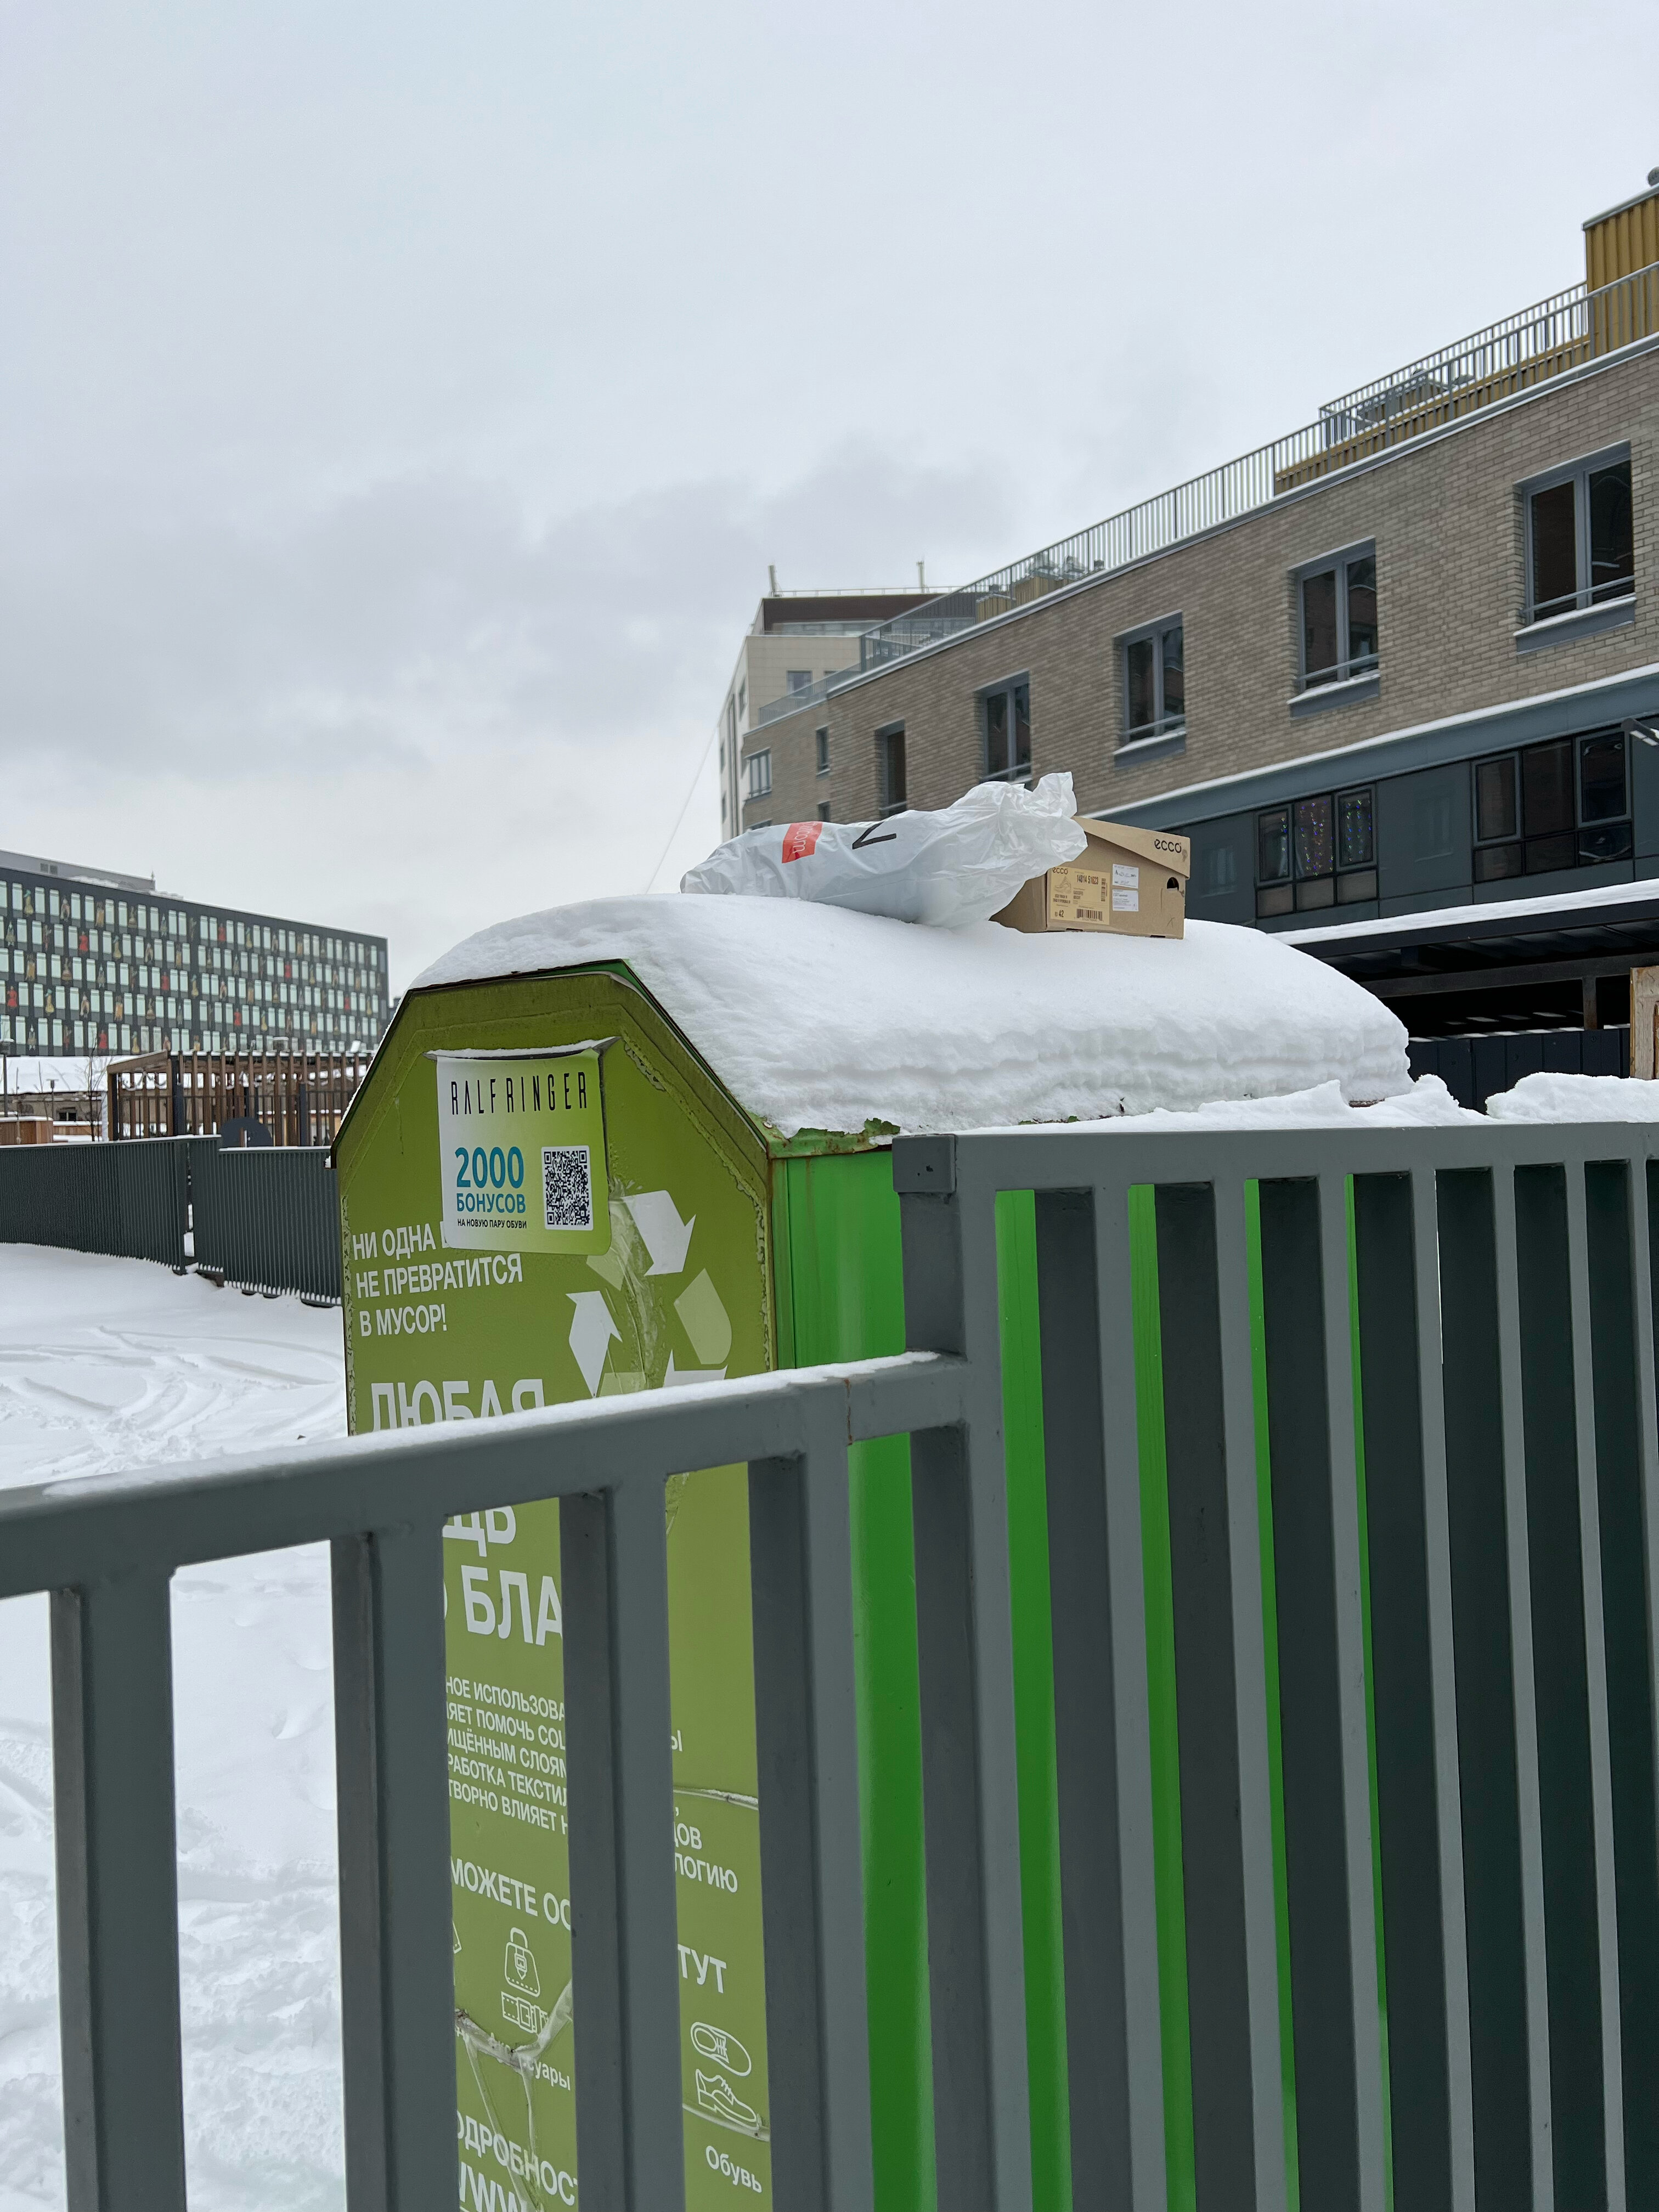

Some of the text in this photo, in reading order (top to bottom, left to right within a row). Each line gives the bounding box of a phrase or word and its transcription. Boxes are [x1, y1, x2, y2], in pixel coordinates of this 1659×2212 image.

[1154, 839, 1182, 854] ecco
[1059, 910, 1064, 918] 42
[455, 1146, 524, 1189] 2000
[456, 1193, 526, 1214] БОНУСОВ
[458, 1218, 527, 1229] НА НОВУЮ ПАРУ ОБУВИ
[353, 1232, 378, 1260] НИ
[382, 1223, 437, 1261] ОДНА
[356, 1252, 523, 1299] НЕ ПРЕВРАТИТСЯ
[359, 1304, 448, 1337] В МУСОР!
[447, 1702, 472, 1725] ЯЕТ
[476, 1708, 535, 1742] ПОМОЧЬ
[501, 1796, 557, 1831] ВЛИЯЕТ
[678, 1944, 727, 1994] ТУТ
[706, 2145, 763, 2193] Обувь
